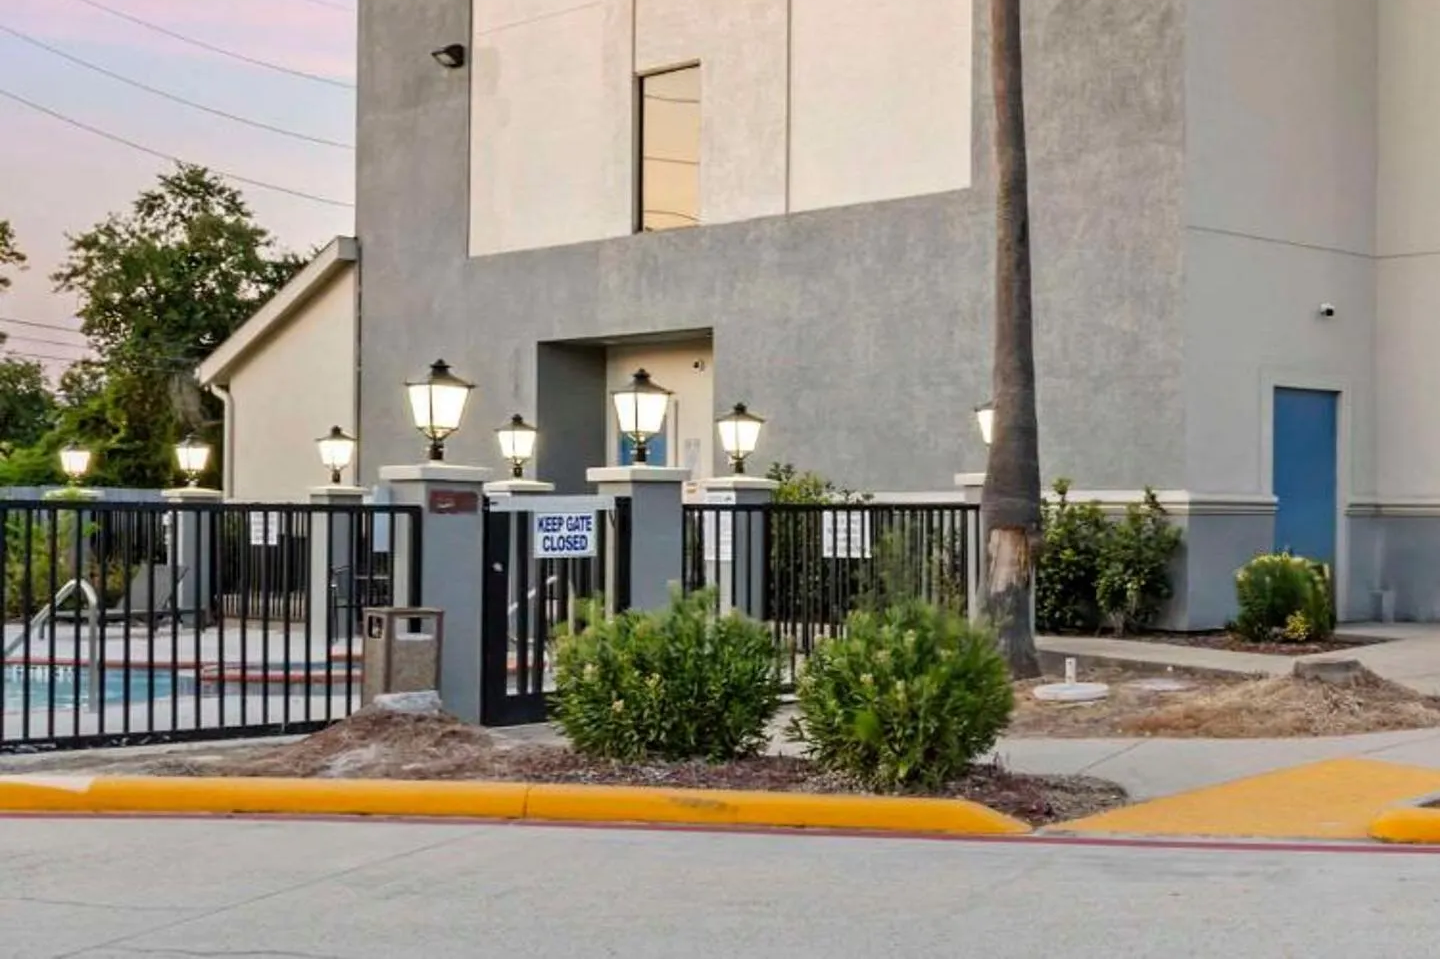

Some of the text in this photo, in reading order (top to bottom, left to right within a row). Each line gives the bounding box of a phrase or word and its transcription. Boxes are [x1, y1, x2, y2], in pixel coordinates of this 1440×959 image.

[537, 515, 592, 532] KEEP GATE
[543, 534, 588, 552] CLOSED
